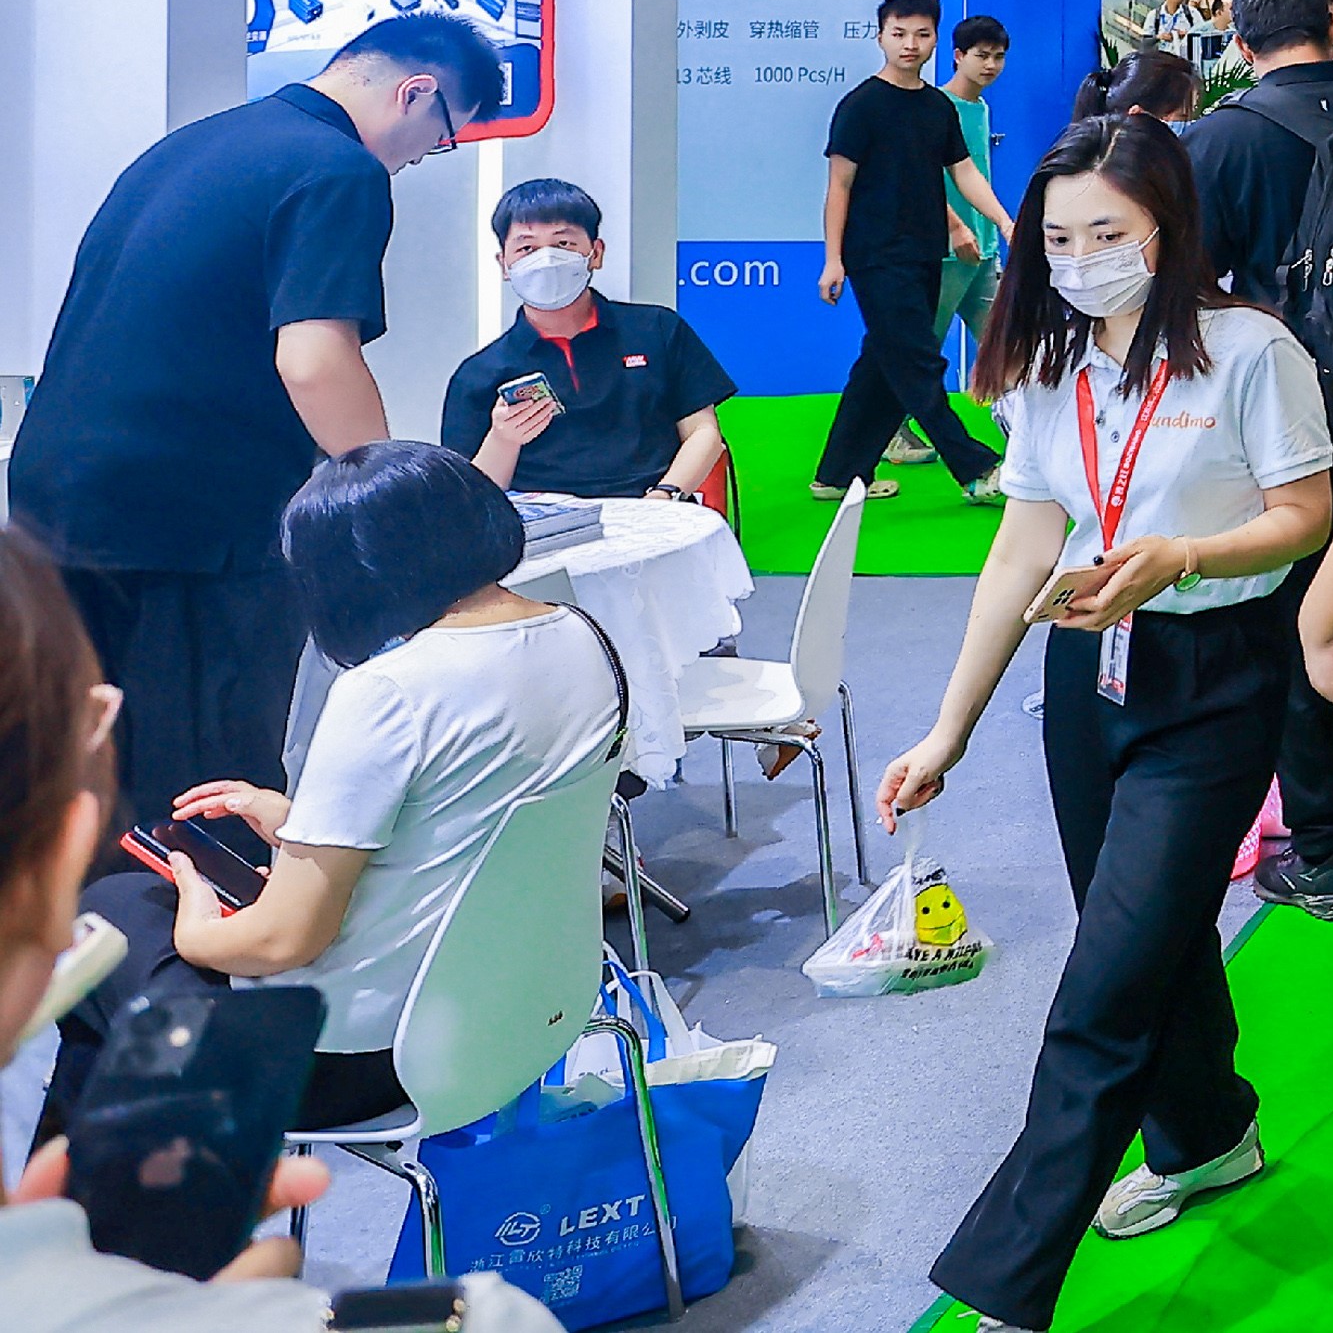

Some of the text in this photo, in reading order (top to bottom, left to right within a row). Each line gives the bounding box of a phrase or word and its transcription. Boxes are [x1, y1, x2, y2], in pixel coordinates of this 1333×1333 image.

[749, 19, 820, 40] 穿热缩管
[696, 67, 732, 85] 芯线
[754, 66, 794, 83] 1000
[798, 66, 846, 86] Pcs/H
[1150, 410, 1216, 429] undimo
[559, 1194, 646, 1237] LEXT
[470, 1216, 677, 1273] 浙江雷欣特科技有限公
